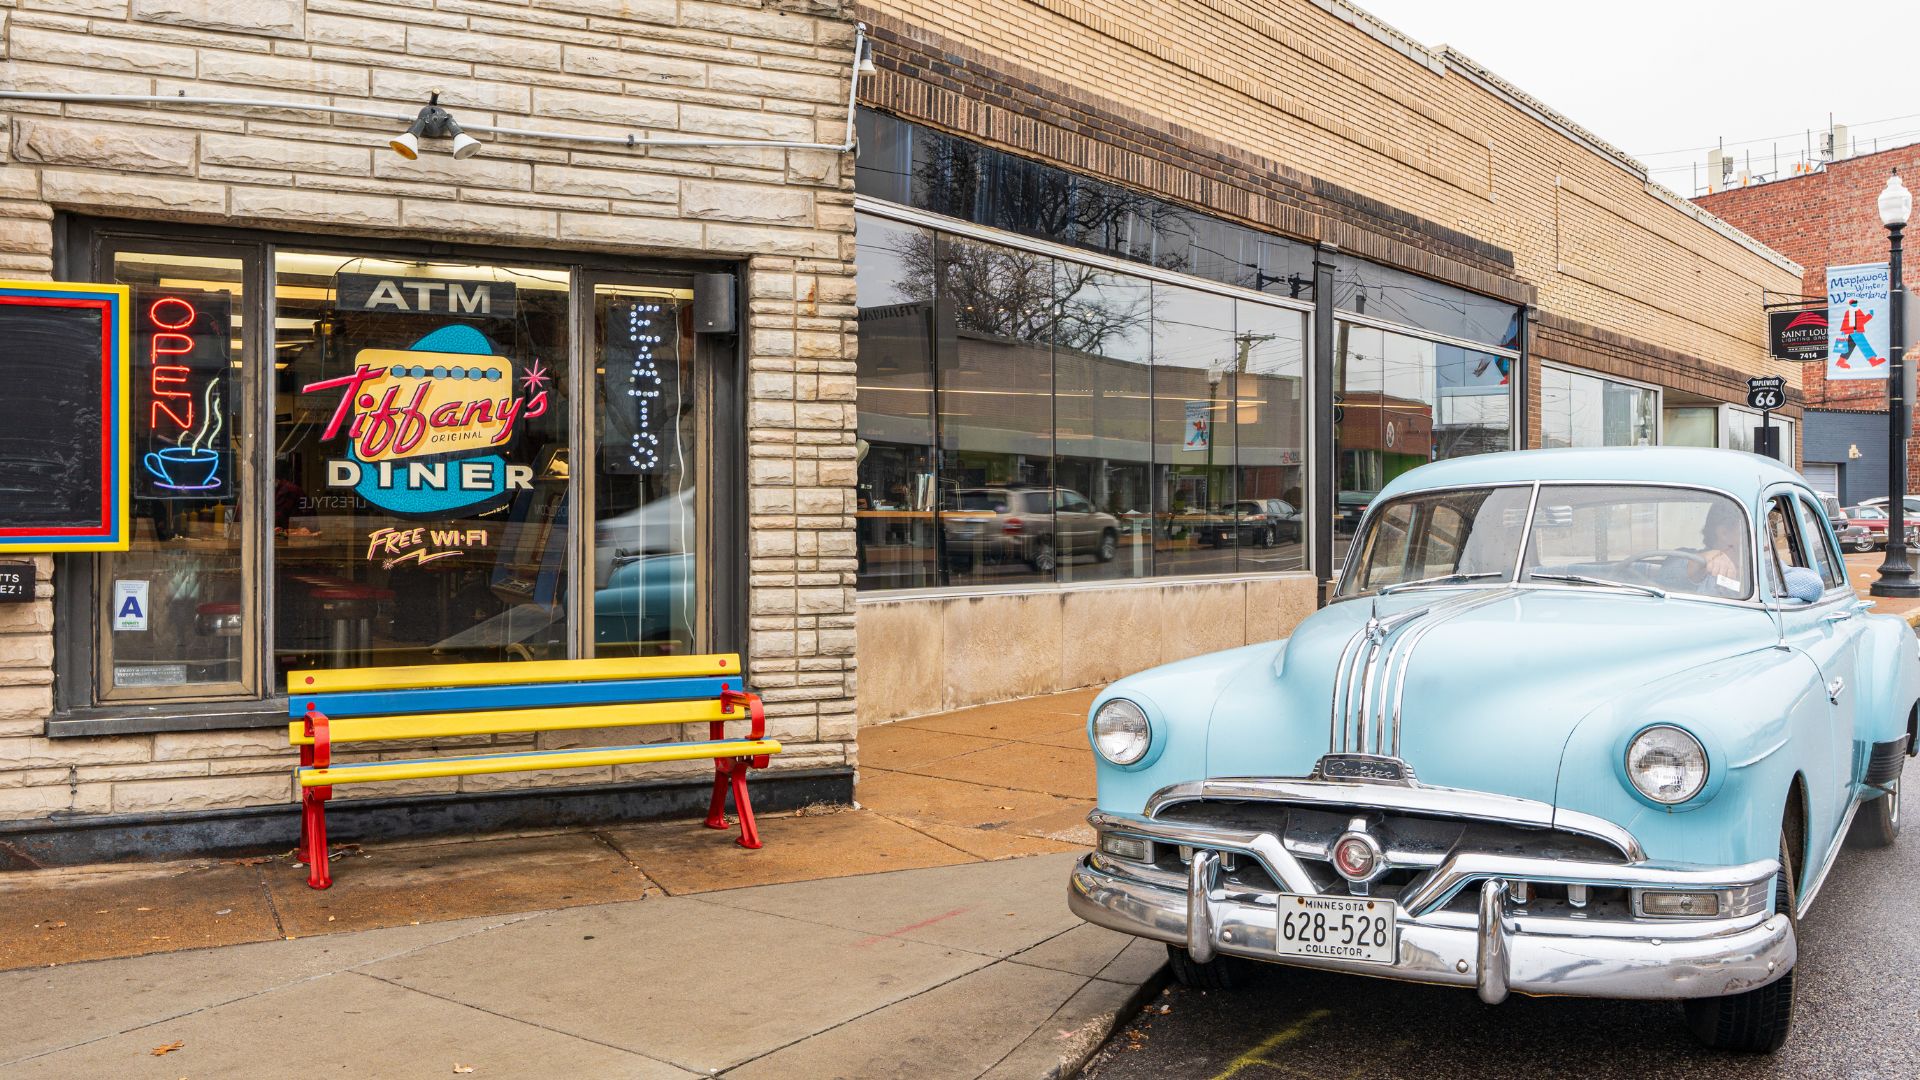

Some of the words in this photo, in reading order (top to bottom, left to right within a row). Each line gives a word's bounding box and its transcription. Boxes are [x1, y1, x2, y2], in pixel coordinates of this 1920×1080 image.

[1830, 272, 1888, 289] Maplewood
[1854, 283, 1885, 292] Winter
[363, 280, 491, 314] ATM
[1830, 291, 1888, 304] Wonderland
[1781, 329, 1807, 339] SAINT
[150, 297, 195, 430] OPEN
[627, 304, 661, 470] EATS
[1751, 379, 1779, 387] MAPLEWOOD
[1755, 391, 1776, 406] 66
[301, 360, 551, 458] Tiffany's
[431, 431, 483, 443] ORIGINAL
[327, 460, 535, 491] DINER
[366, 527, 426, 561] FREE
[118, 596, 143, 618] A
[1305, 900, 1365, 912] MINNESOTA
[1283, 911, 1387, 948] 628-528
[1305, 943, 1363, 957] COLLECTOR
